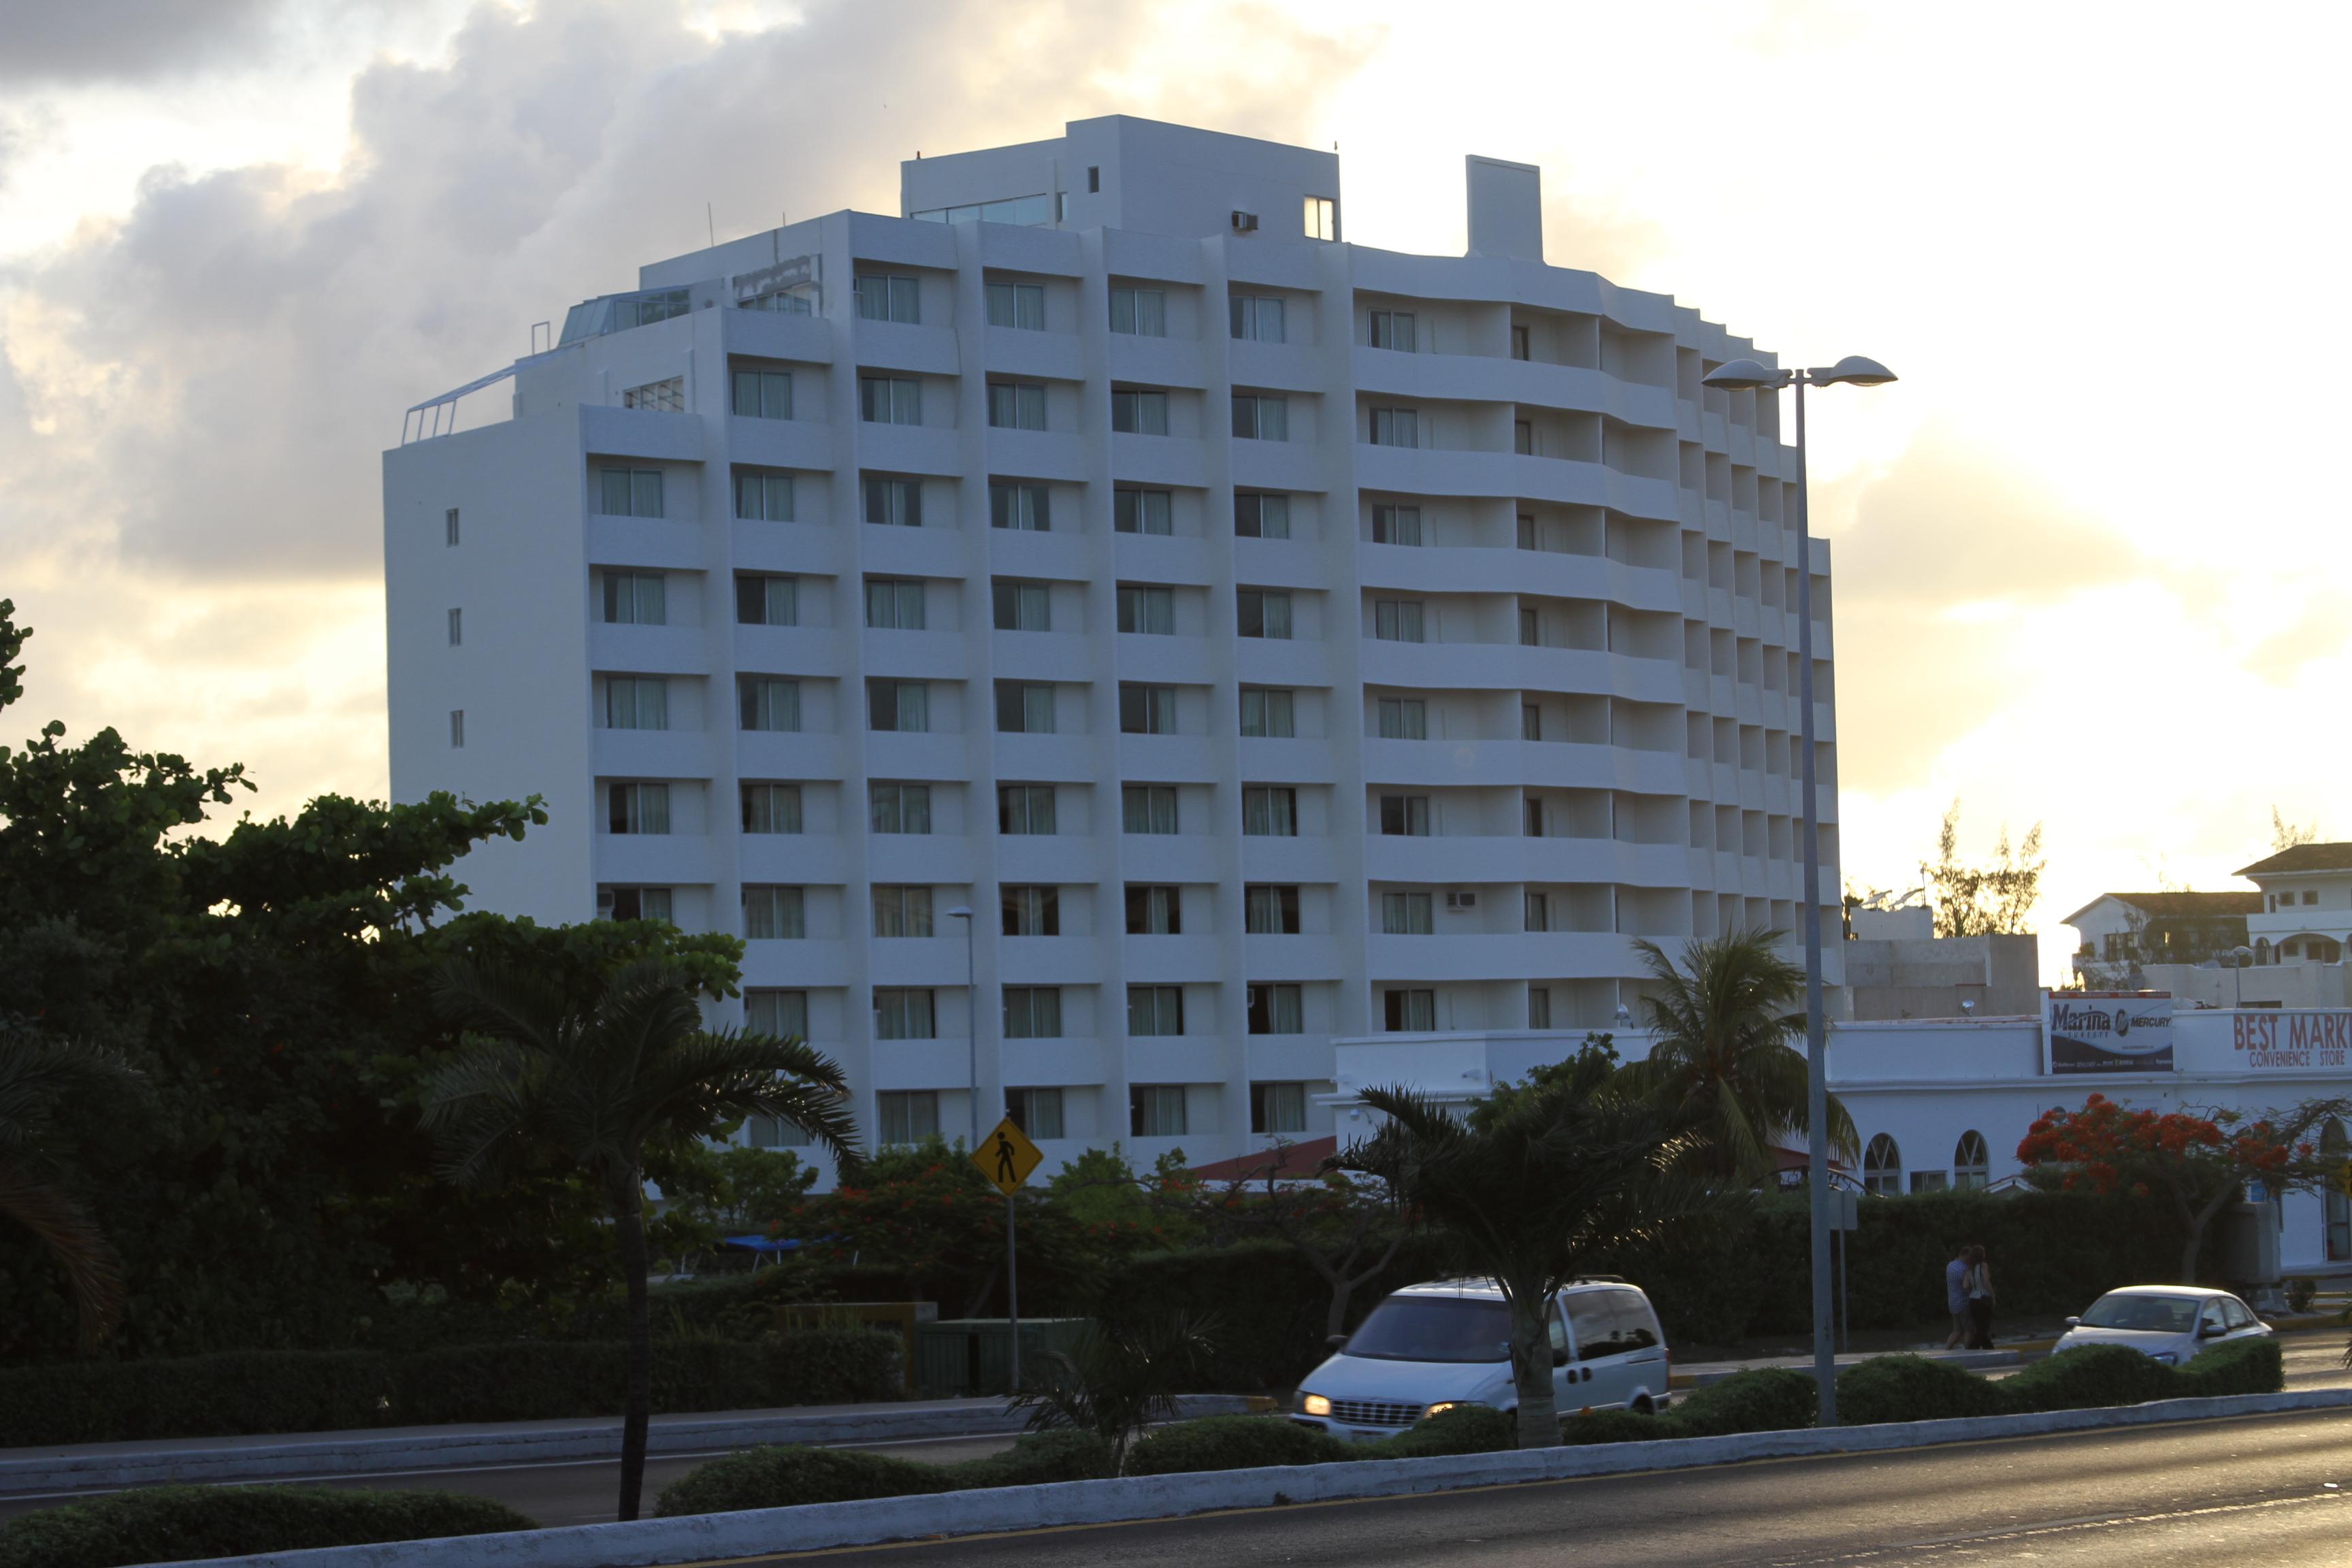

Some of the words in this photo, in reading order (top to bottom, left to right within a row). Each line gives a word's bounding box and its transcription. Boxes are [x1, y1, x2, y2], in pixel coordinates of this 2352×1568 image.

[2051, 1003, 2110, 1031] Marina
[2130, 1017, 2171, 1028] MERCURY
[2234, 1014, 2278, 1051] BEST
[2250, 1051, 2310, 1067] CONVENIENCE
[2319, 1050, 2345, 1066] STORE
